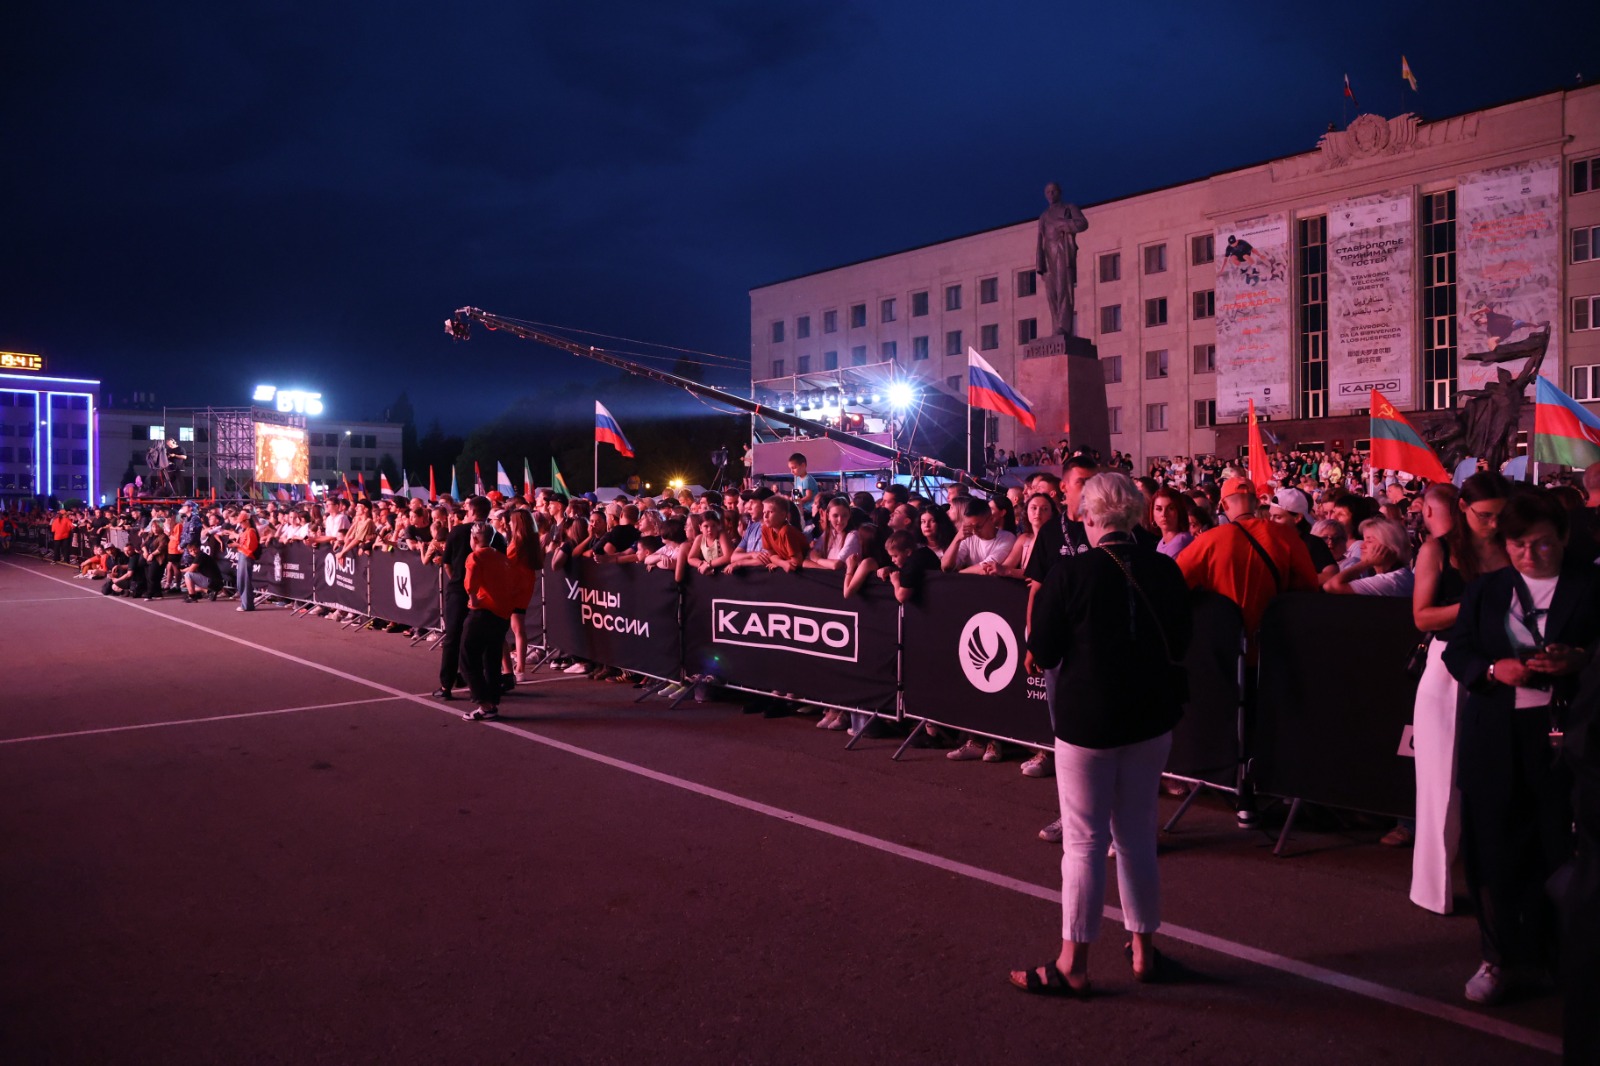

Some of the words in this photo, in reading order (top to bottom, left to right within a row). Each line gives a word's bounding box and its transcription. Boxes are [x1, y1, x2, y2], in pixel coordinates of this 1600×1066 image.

[1335, 238, 1404, 255] СТАВРОПОЛЬЕ
[1340, 247, 1399, 261] ПРИНИМАЕТ
[1351, 255, 1388, 267] ГОСТЕЙ
[1350, 323, 1390, 332] STAVROPOL
[1341, 382, 1397, 393] KARDO
[565, 577, 621, 609] Улицы
[581, 604, 650, 638] России
[718, 609, 850, 648] KARDO
[1026, 676, 1047, 687] ФЕД
[1026, 689, 1047, 700] УНИ
